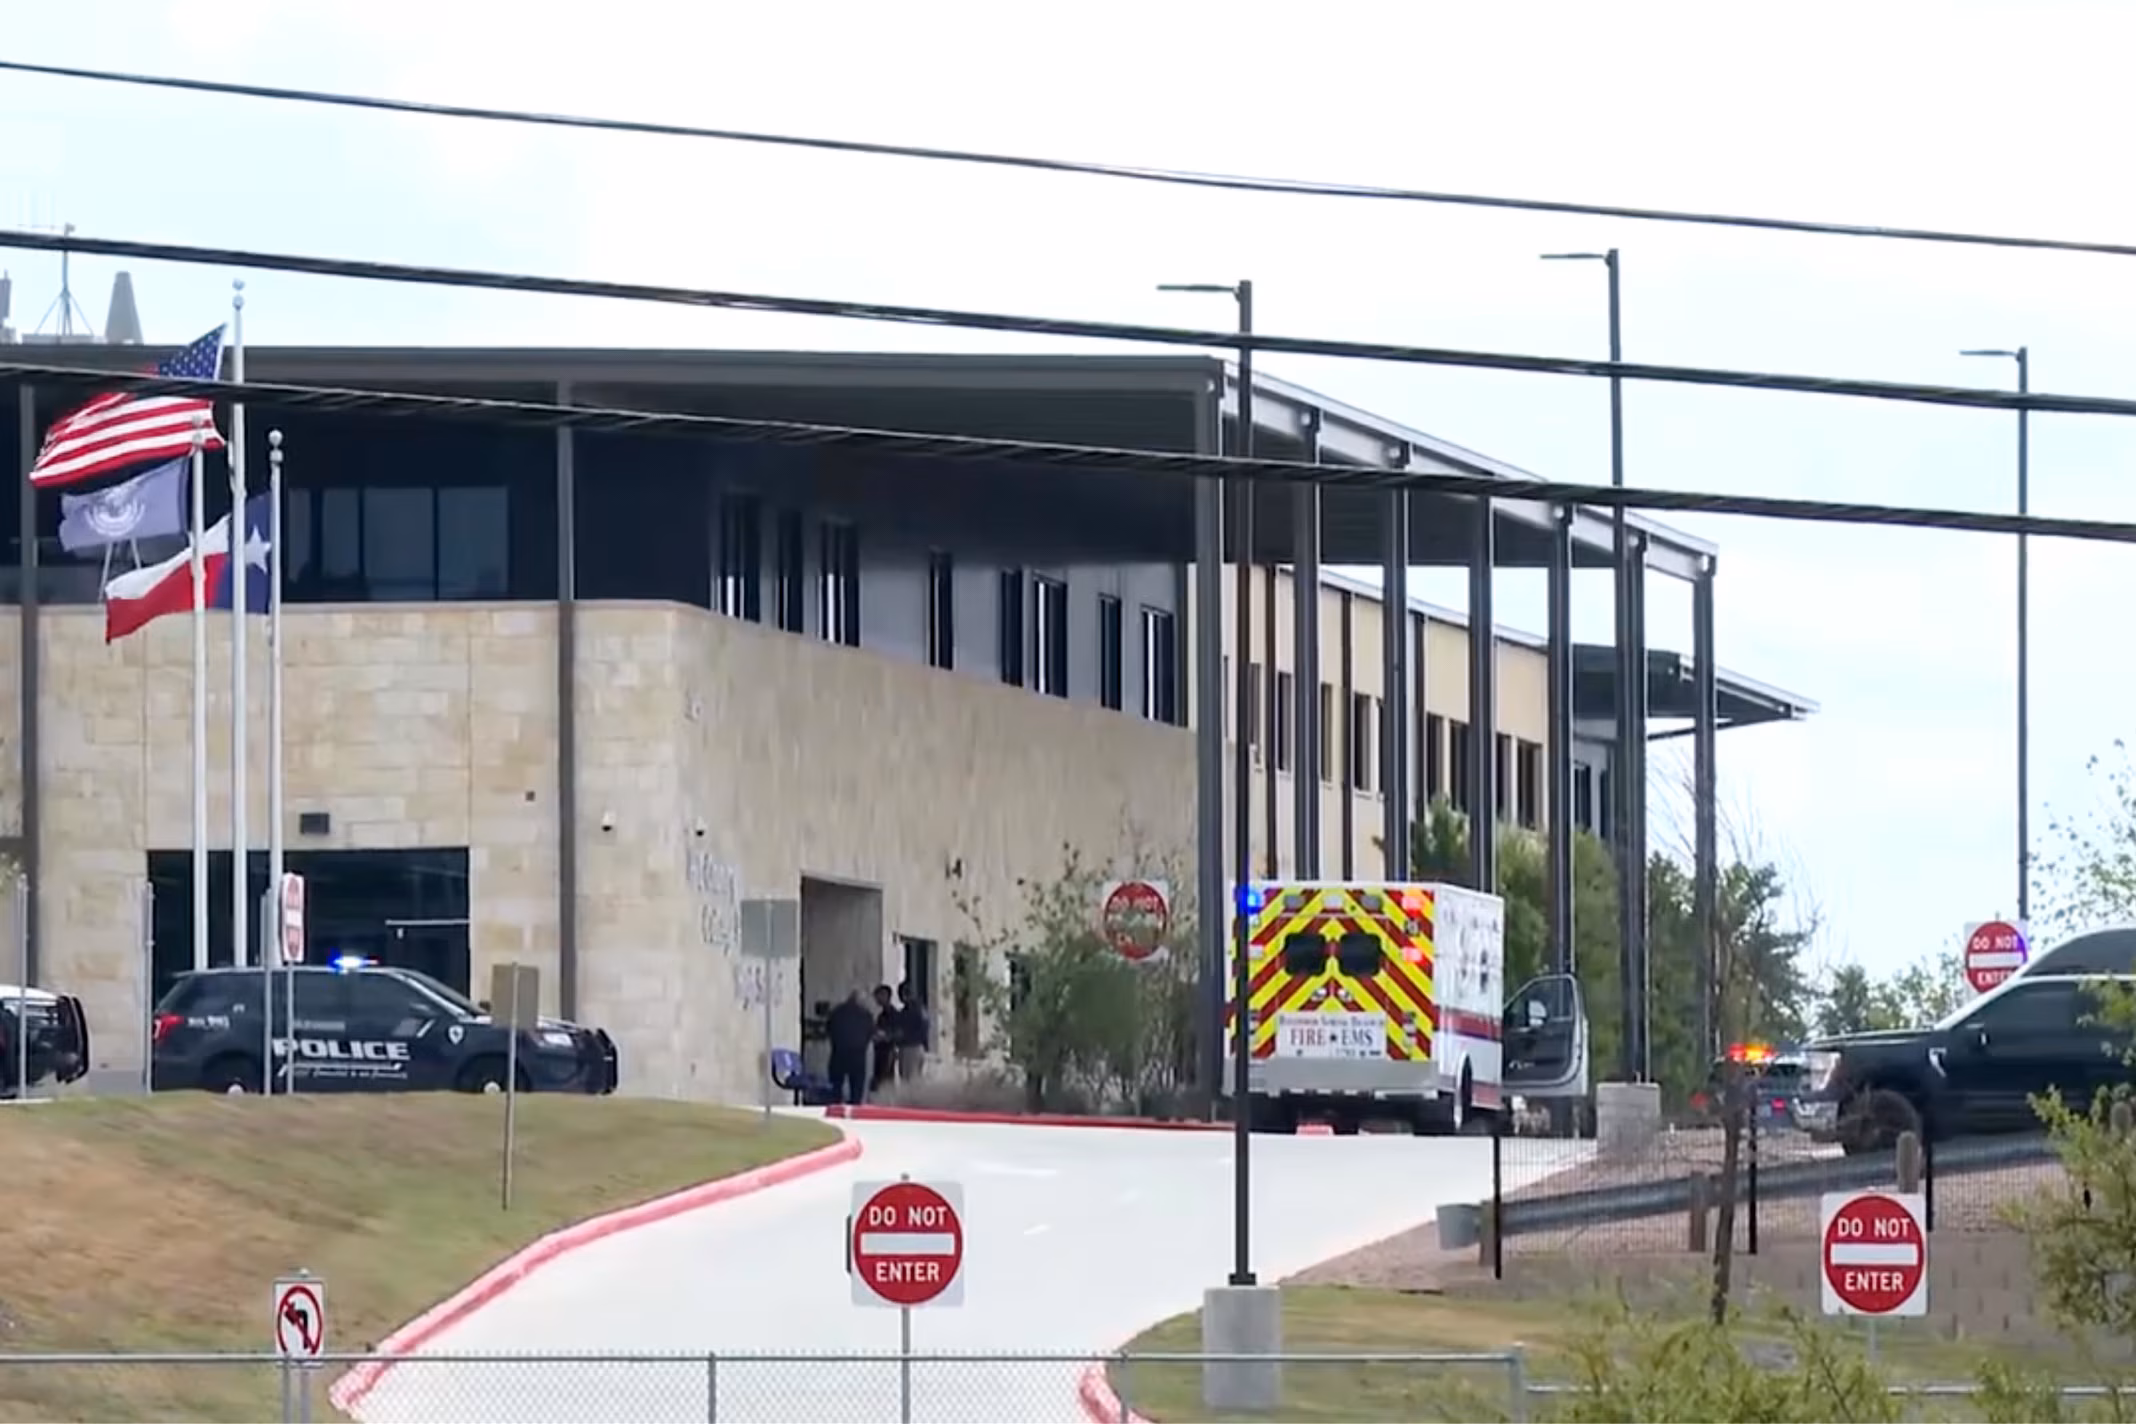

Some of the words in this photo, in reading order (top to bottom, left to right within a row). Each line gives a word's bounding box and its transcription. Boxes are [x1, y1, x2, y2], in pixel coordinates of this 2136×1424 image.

[1973, 936, 1990, 950] DO
[1995, 935, 2018, 950] NOT
[1290, 1028, 1326, 1046] FIRE
[1342, 1028, 1374, 1046] EMS
[272, 1038, 410, 1060] POLICE
[869, 1206, 896, 1226] DO
[908, 1206, 947, 1226] NOT
[1838, 1217, 1863, 1238] DO
[1874, 1217, 1910, 1238] NOT
[876, 1262, 940, 1282] ENTER
[1845, 1272, 1904, 1292] ENTER
